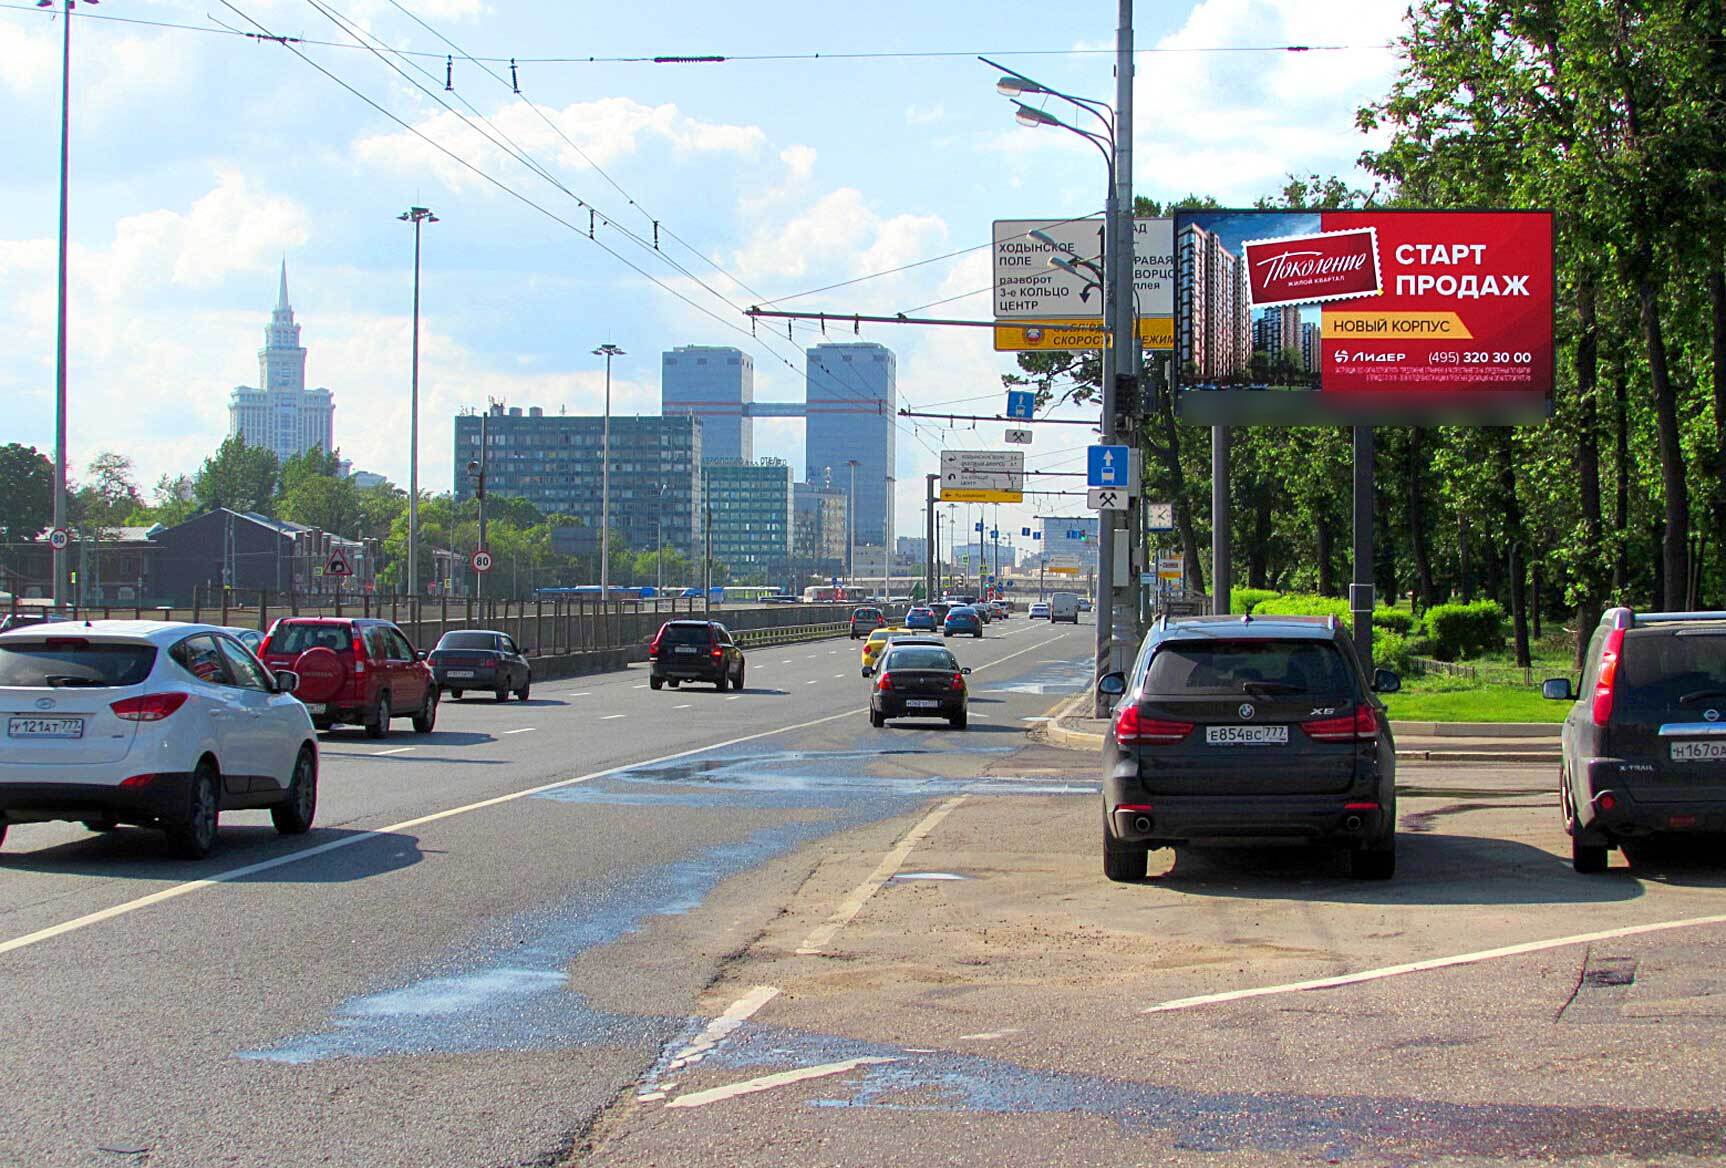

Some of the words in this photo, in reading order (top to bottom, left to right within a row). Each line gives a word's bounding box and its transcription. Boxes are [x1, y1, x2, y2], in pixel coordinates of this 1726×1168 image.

[999, 243, 1075, 254] ХОДЫНСКОЕ
[1395, 244, 1487, 265] СТАРТ
[999, 257, 1031, 266] ПОЛЕ
[1134, 256, 1173, 265] РАВАЯ
[1256, 251, 1367, 288] Поколение
[1000, 277, 1052, 286] разворот
[1288, 278, 1313, 287] ЖИЛОЙ
[1314, 275, 1345, 284] КВАРТАЛ
[1396, 275, 1530, 299] ПРОДАЖ
[1000, 288, 1017, 297] 3-е
[1020, 287, 1069, 299] КОЛЬЦО
[1000, 301, 1039, 312] ЦЕНТР
[1333, 318, 1387, 332] НОВЫЙ
[1392, 320, 1450, 332] КОРПУС
[1428, 351, 1459, 365] (495)
[1463, 352, 1488, 363] 320
[1492, 352, 1510, 363] 30
[1513, 352, 1532, 363] 00
[476, 556, 489, 566] 80
[1265, 727, 1285, 737] 777
